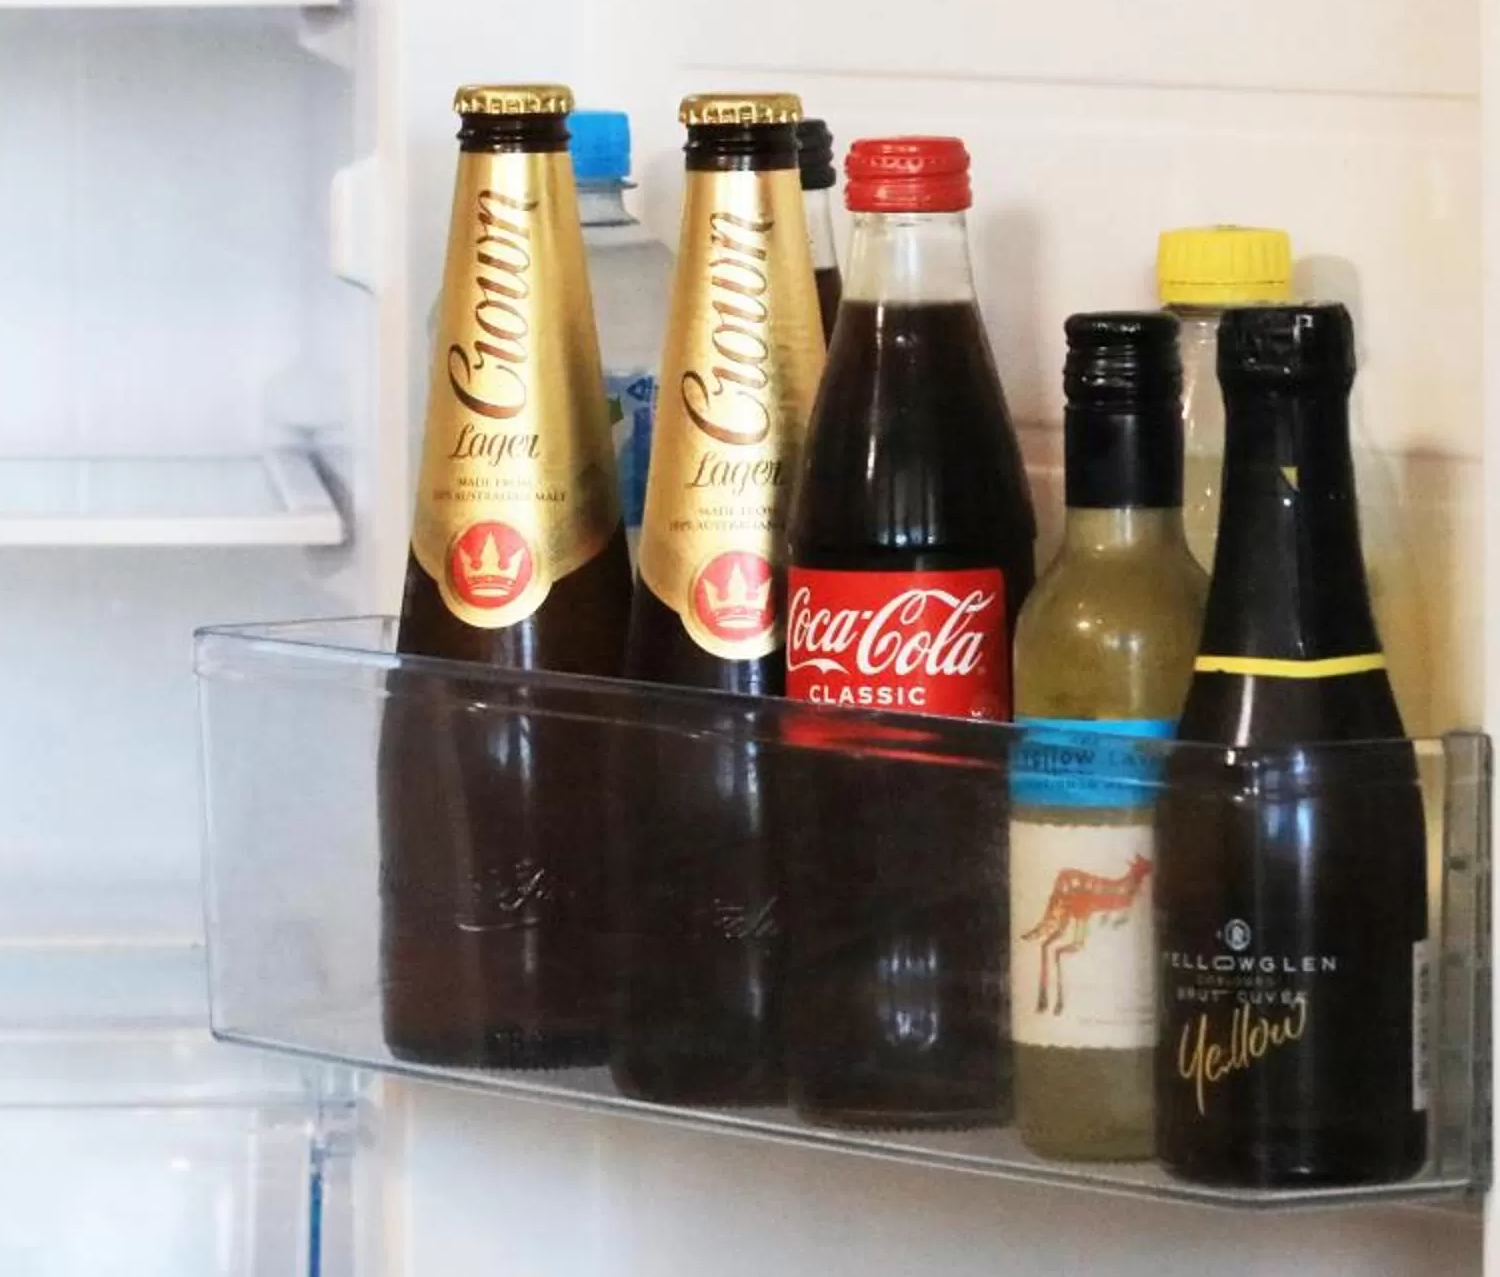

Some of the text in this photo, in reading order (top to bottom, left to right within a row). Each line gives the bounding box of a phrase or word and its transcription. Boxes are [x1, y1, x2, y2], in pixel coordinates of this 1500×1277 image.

[447, 189, 541, 419] Crown
[681, 211, 775, 447] Crown
[448, 422, 542, 467] Lager
[685, 451, 783, 496] Lager
[786, 586, 996, 676] Coca-Cola
[809, 685, 927, 706] CLASSIC
[1178, 996, 1308, 1117] Yellow
